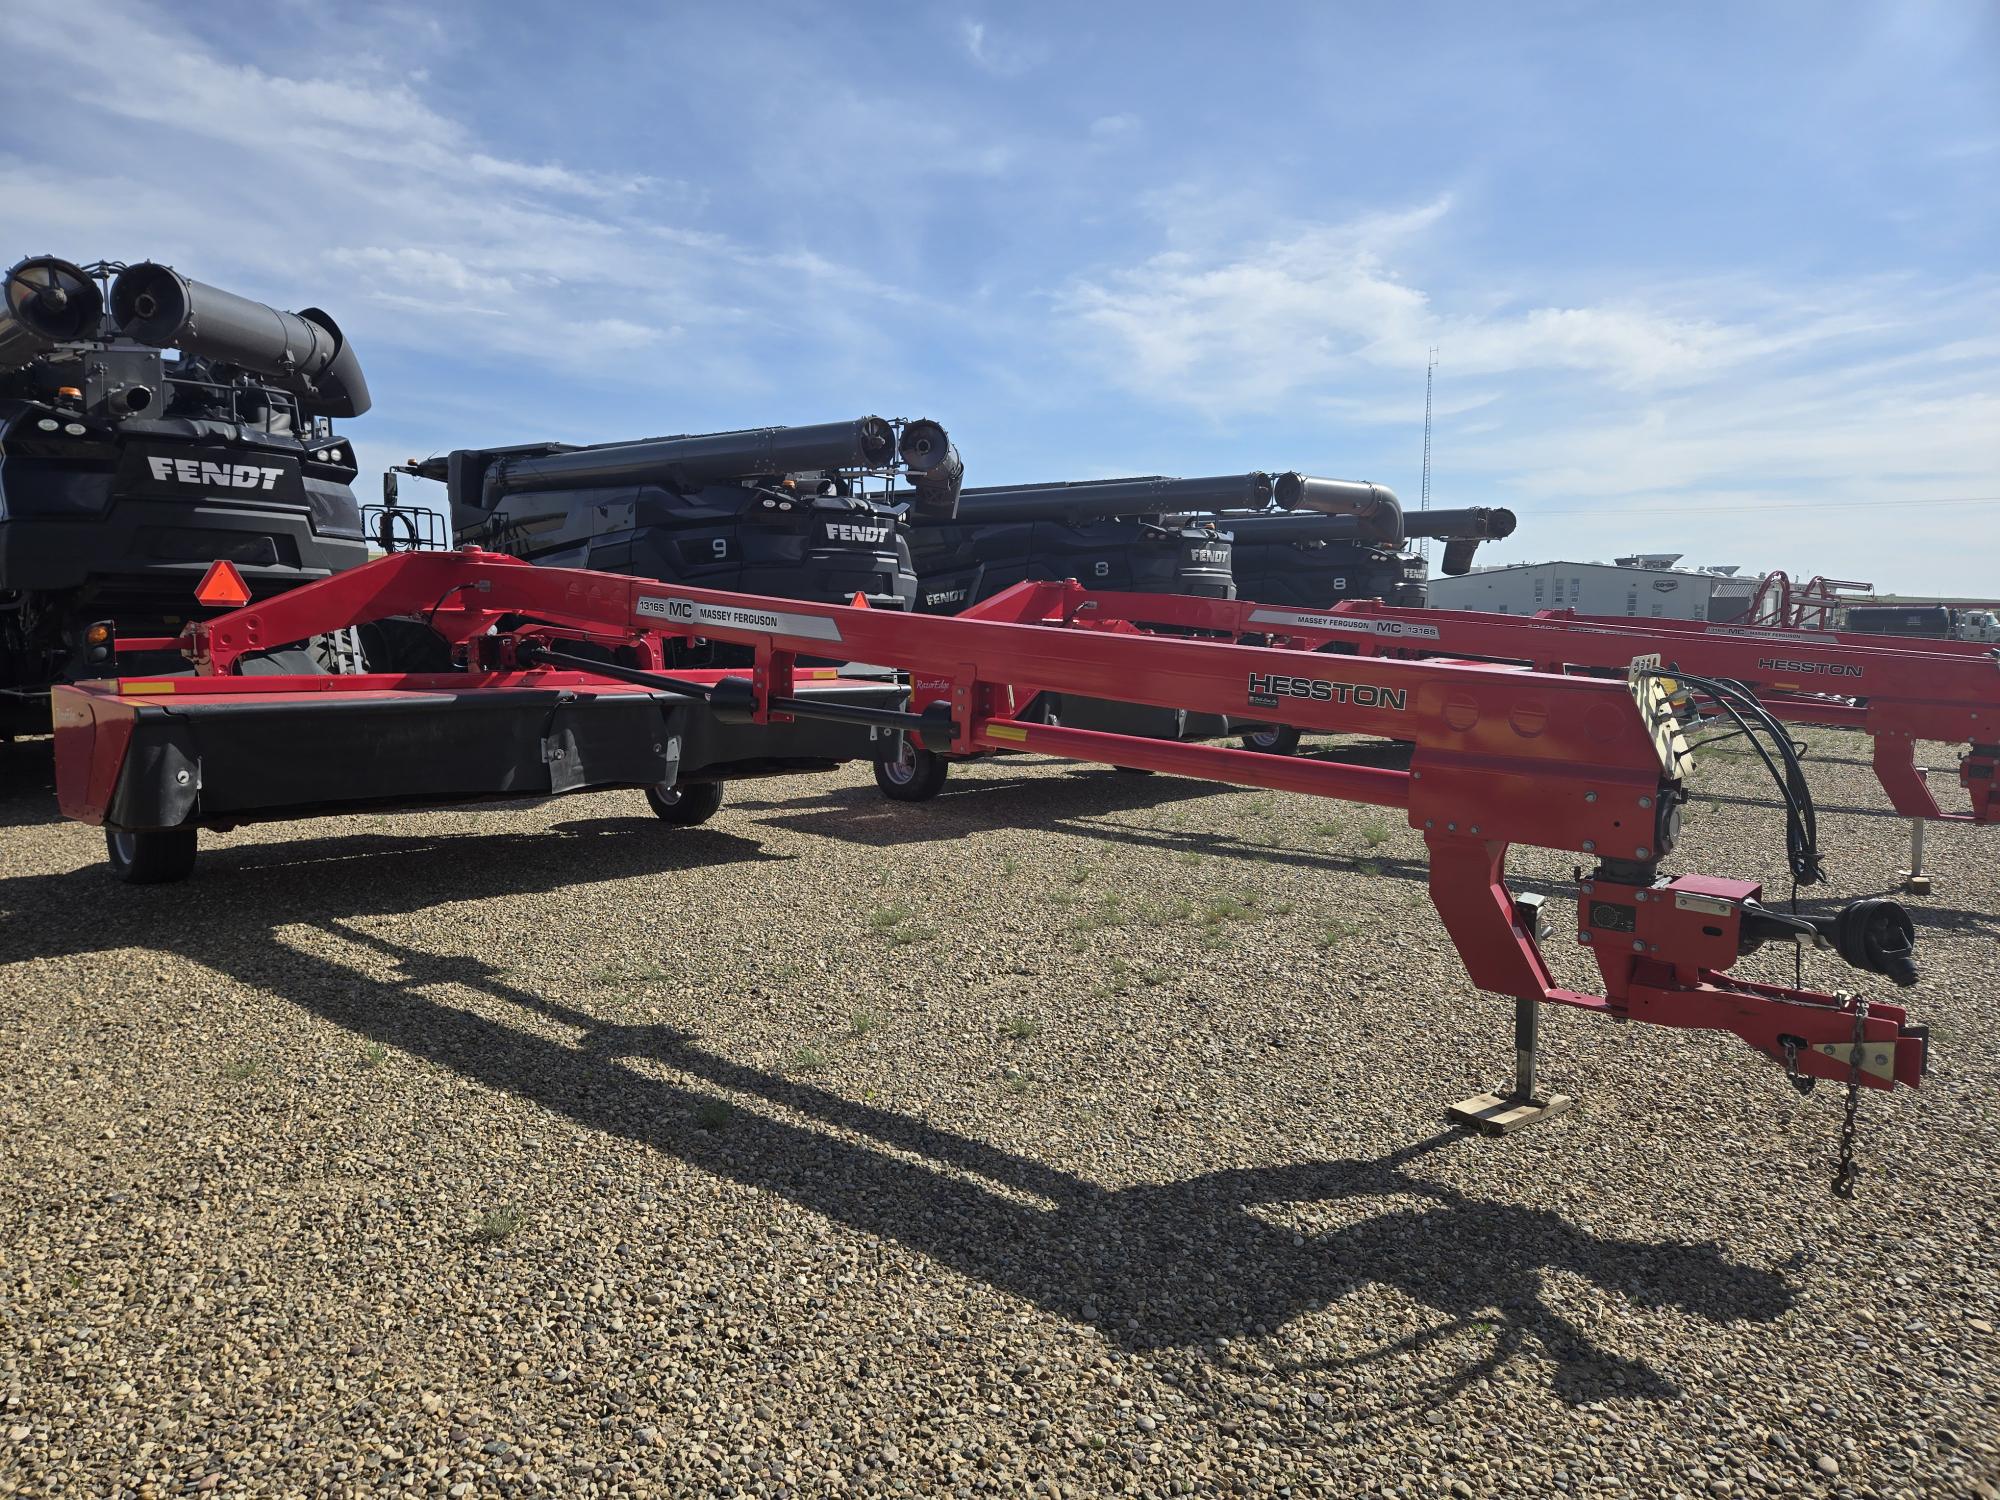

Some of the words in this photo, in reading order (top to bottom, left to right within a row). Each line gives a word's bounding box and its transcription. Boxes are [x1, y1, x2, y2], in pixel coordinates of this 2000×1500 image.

[147, 456, 285, 490] FENDT
[825, 523, 889, 543] FENDT
[712, 538, 727, 559] 9
[1191, 549, 1229, 563] FENDT
[1095, 561, 1109, 576] 8
[1403, 568, 1427, 579] FENDT
[1333, 577, 1346, 590] 8
[926, 589, 967, 606] FENDT
[639, 601, 665, 613] 1316S
[669, 601, 692, 618] MC
[700, 608, 732, 621] MASSEY
[733, 612, 778, 627] FERGUSON
[1297, 616, 1328, 625] MASSEY
[1329, 619, 1369, 630] FERGUSON
[1376, 621, 1402, 634] MC
[1407, 626, 1436, 636] 1316S
[1758, 657, 1864, 677] HESSTON
[1248, 672, 1407, 711] HESSTON
